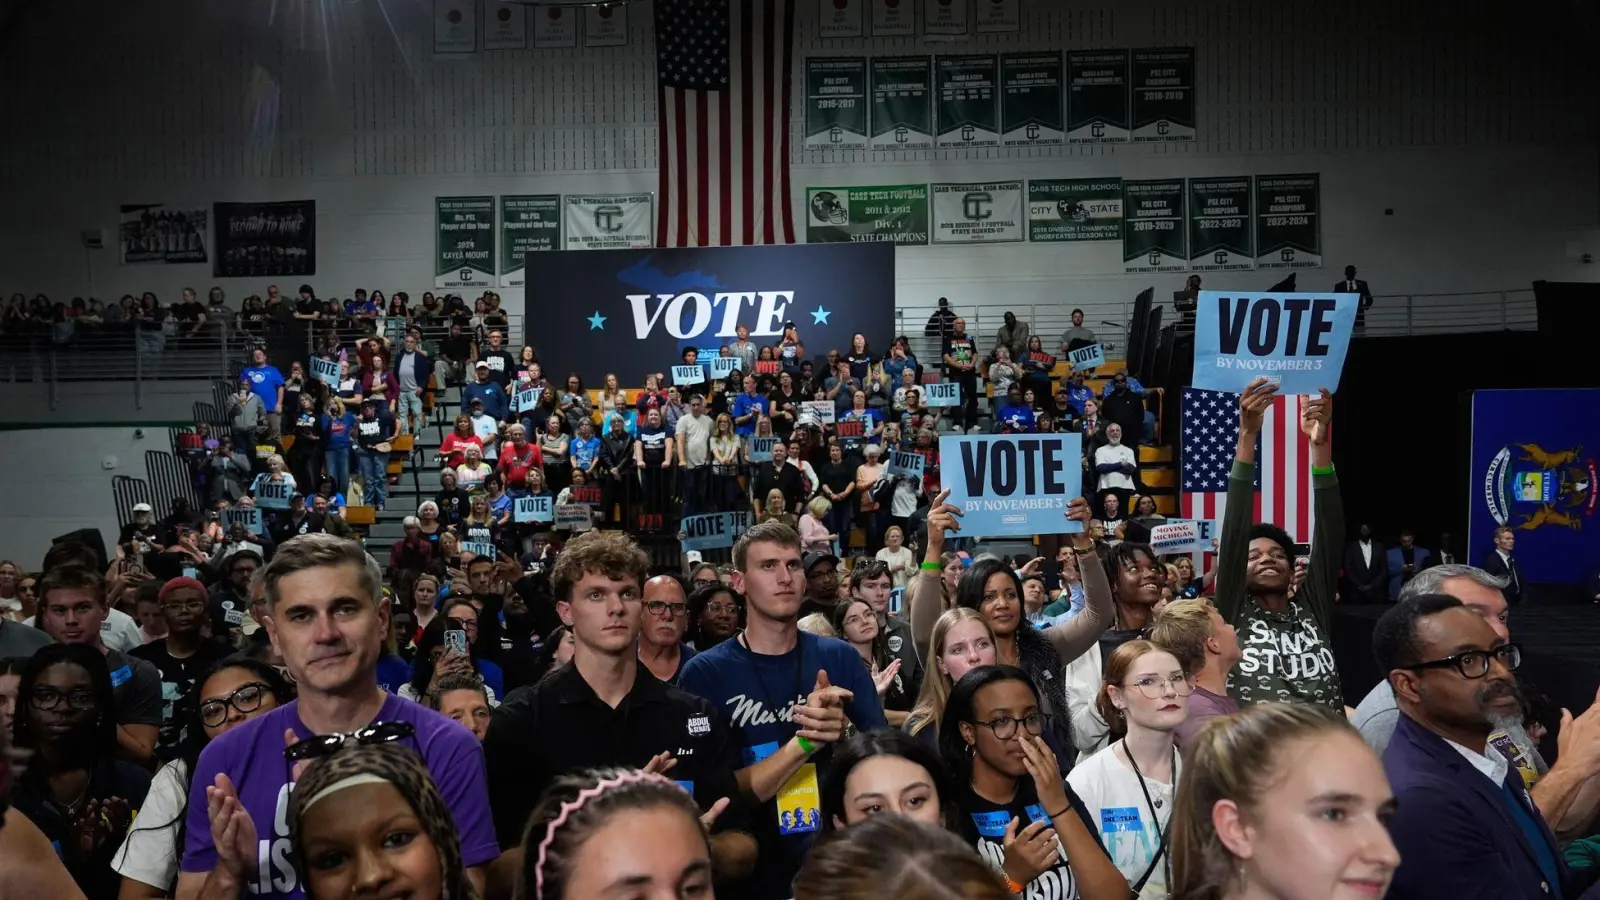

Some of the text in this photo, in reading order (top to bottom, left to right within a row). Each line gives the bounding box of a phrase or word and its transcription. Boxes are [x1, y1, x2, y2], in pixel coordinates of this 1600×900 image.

[850, 189, 925, 200] CASS TECH FOOTBALL
[884, 206, 890, 214] &
[892, 206, 911, 214] 2012
[1031, 206, 1051, 214] CITY
[1090, 204, 1119, 212] STATE
[875, 220, 894, 228] Div.
[1134, 222, 1174, 230] 2019-2020
[1200, 219, 1241, 228] 2022-2023
[850, 232, 926, 242] STATE CHAMPIONS
[465, 251, 488, 259] MOUNT
[626, 290, 794, 339] VOTE
[1218, 298, 1336, 356] VOTE
[1073, 346, 1098, 363] VOTE
[313, 360, 337, 376] VOTE
[715, 359, 737, 370] VOTE
[755, 361, 779, 374] VOTE
[1216, 357, 1323, 371] BY NOVEMBER 3
[676, 366, 699, 378] VOTE
[522, 390, 538, 404] VOT
[931, 384, 955, 398] VOTE
[836, 421, 862, 436] VOTE
[754, 439, 777, 452] VOT
[894, 451, 921, 469] VOTE
[960, 439, 1065, 497] VOTE
[260, 484, 287, 498] VOTE
[574, 487, 601, 502] VOTE
[520, 499, 547, 512] VOTE
[965, 498, 1062, 512] BY NOVEMBER 3
[226, 510, 256, 524] VOTE
[686, 515, 724, 538] VOTE
[1156, 525, 1189, 534] MOVING
[1153, 532, 1193, 540] MICHIGAN
